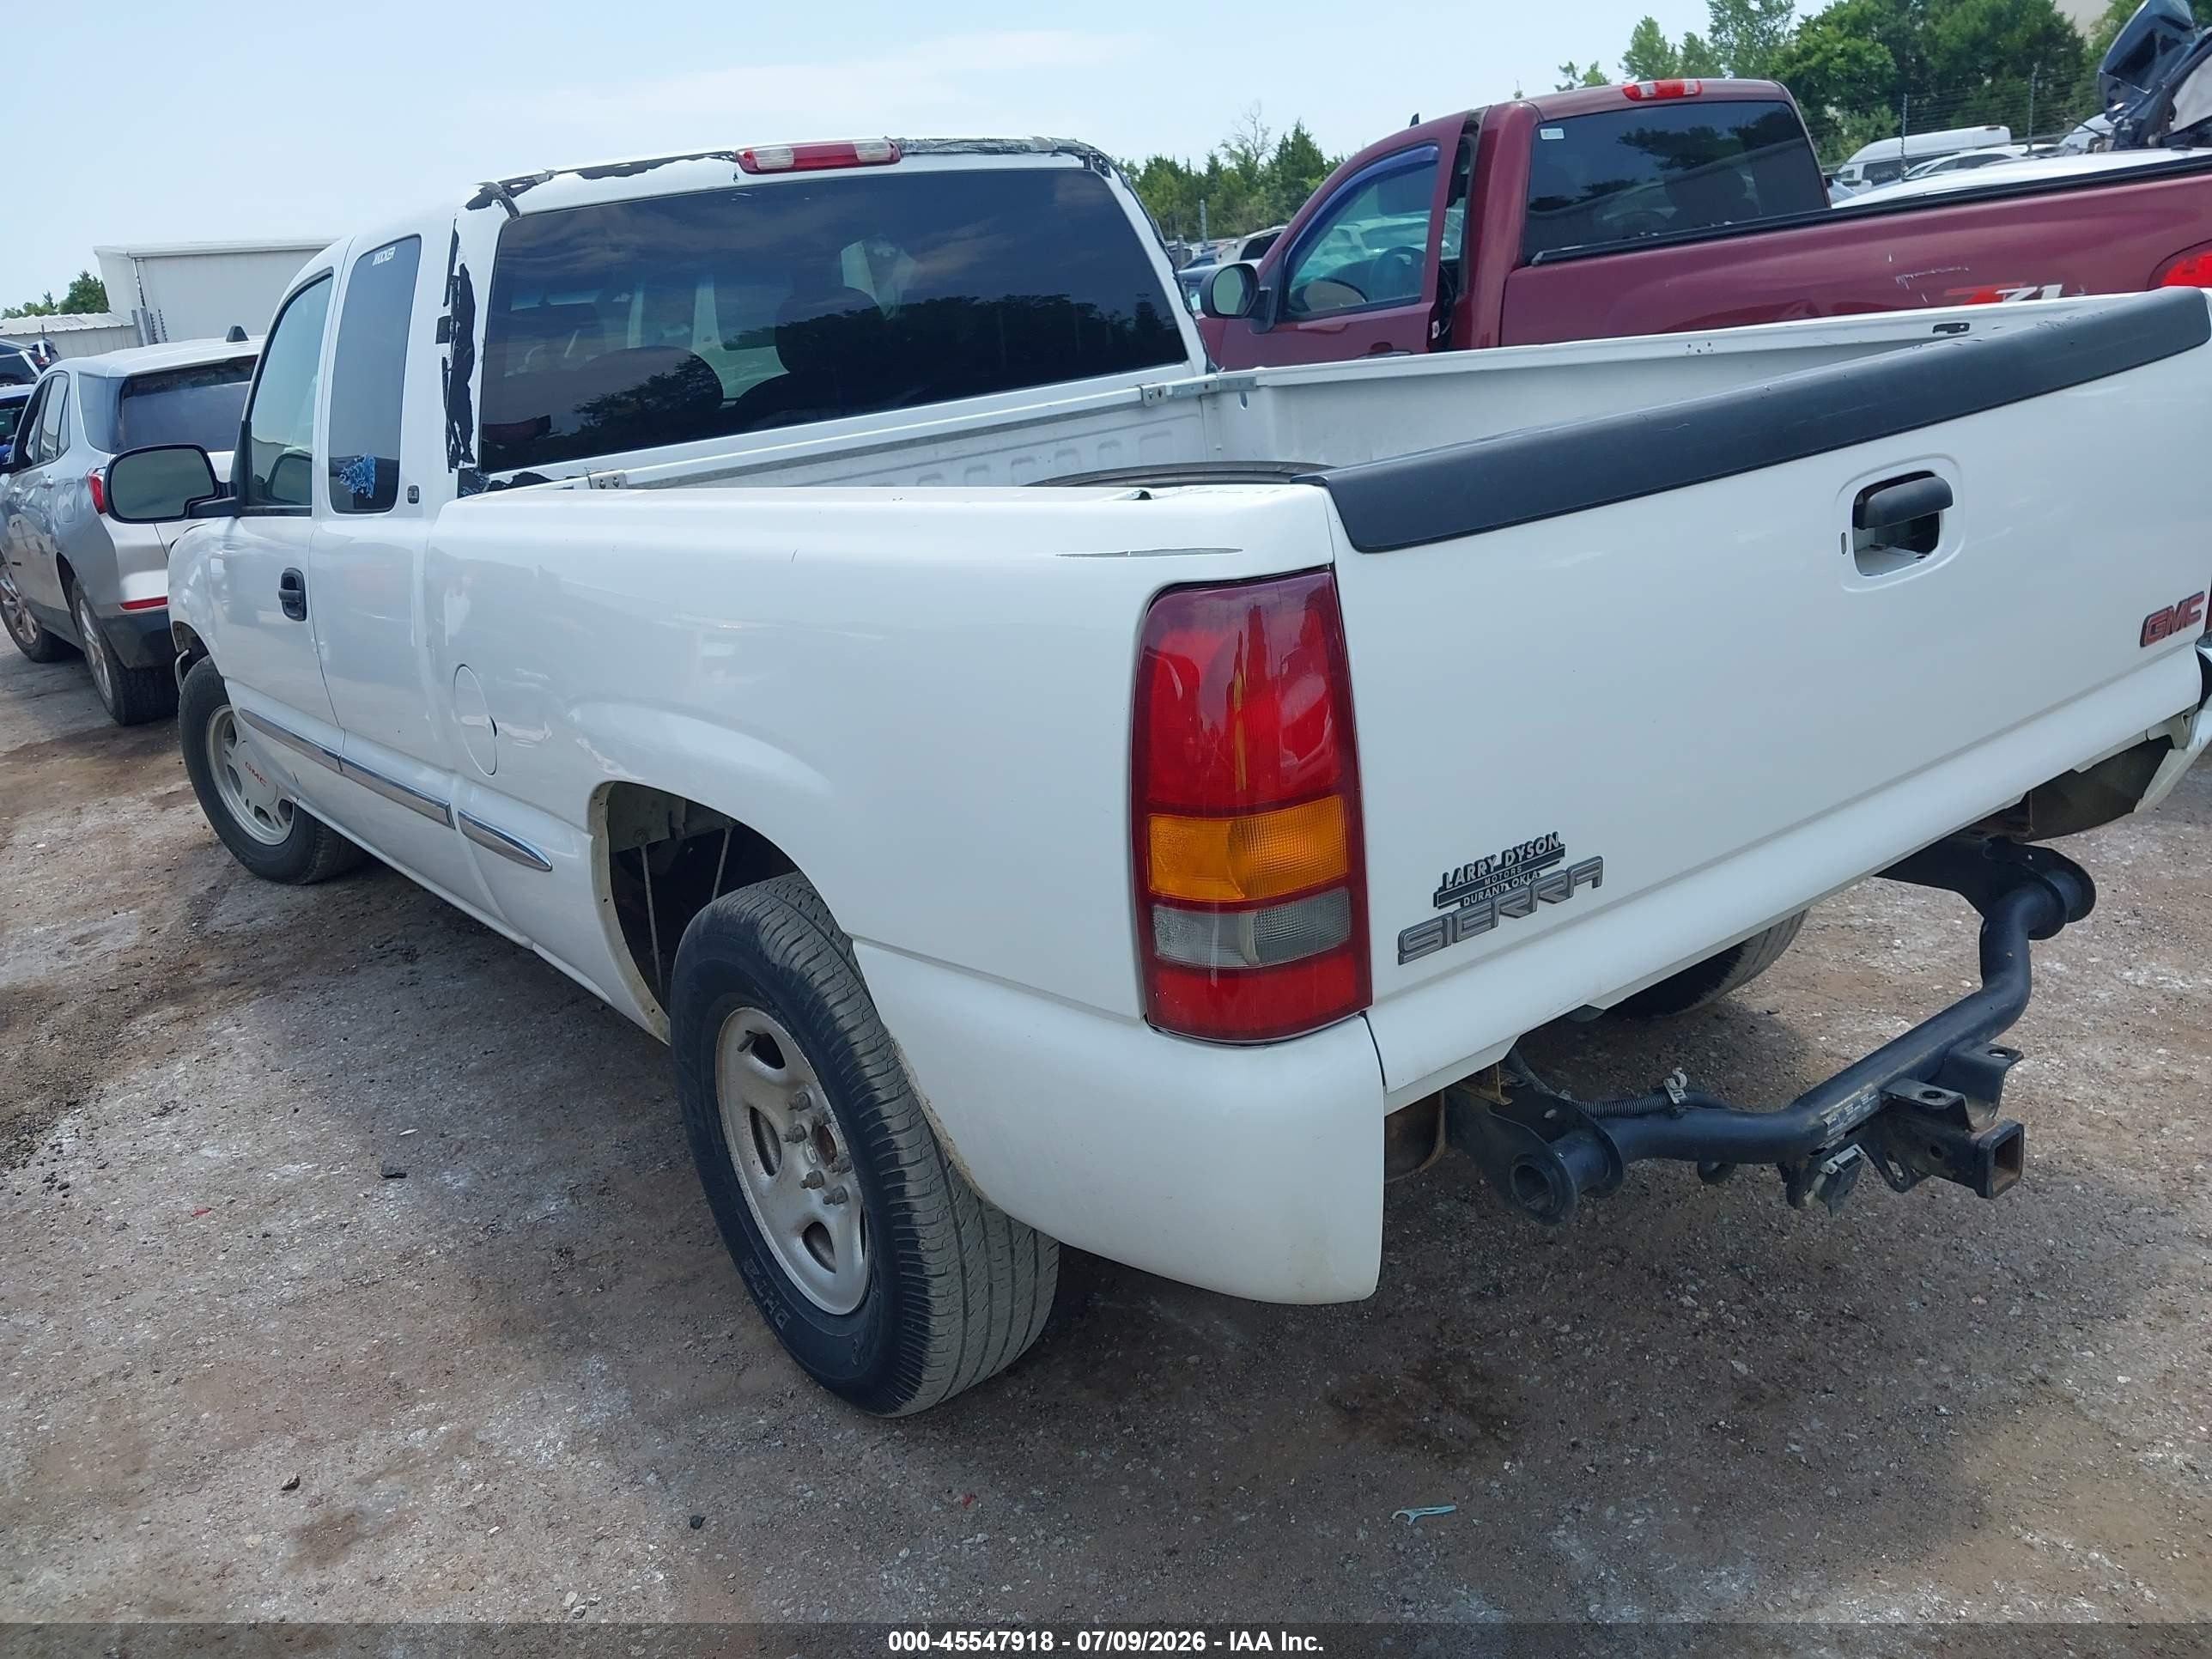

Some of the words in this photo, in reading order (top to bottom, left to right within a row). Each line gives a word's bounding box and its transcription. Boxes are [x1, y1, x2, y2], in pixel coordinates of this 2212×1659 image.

[2139, 590, 2204, 647] GMC
[245, 762, 267, 787] GMC
[1443, 854, 1497, 890] LARRY
[1503, 831, 1561, 867] DYSON
[1484, 866, 1522, 886] MOTORS
[1398, 855, 1603, 965] SIERRA
